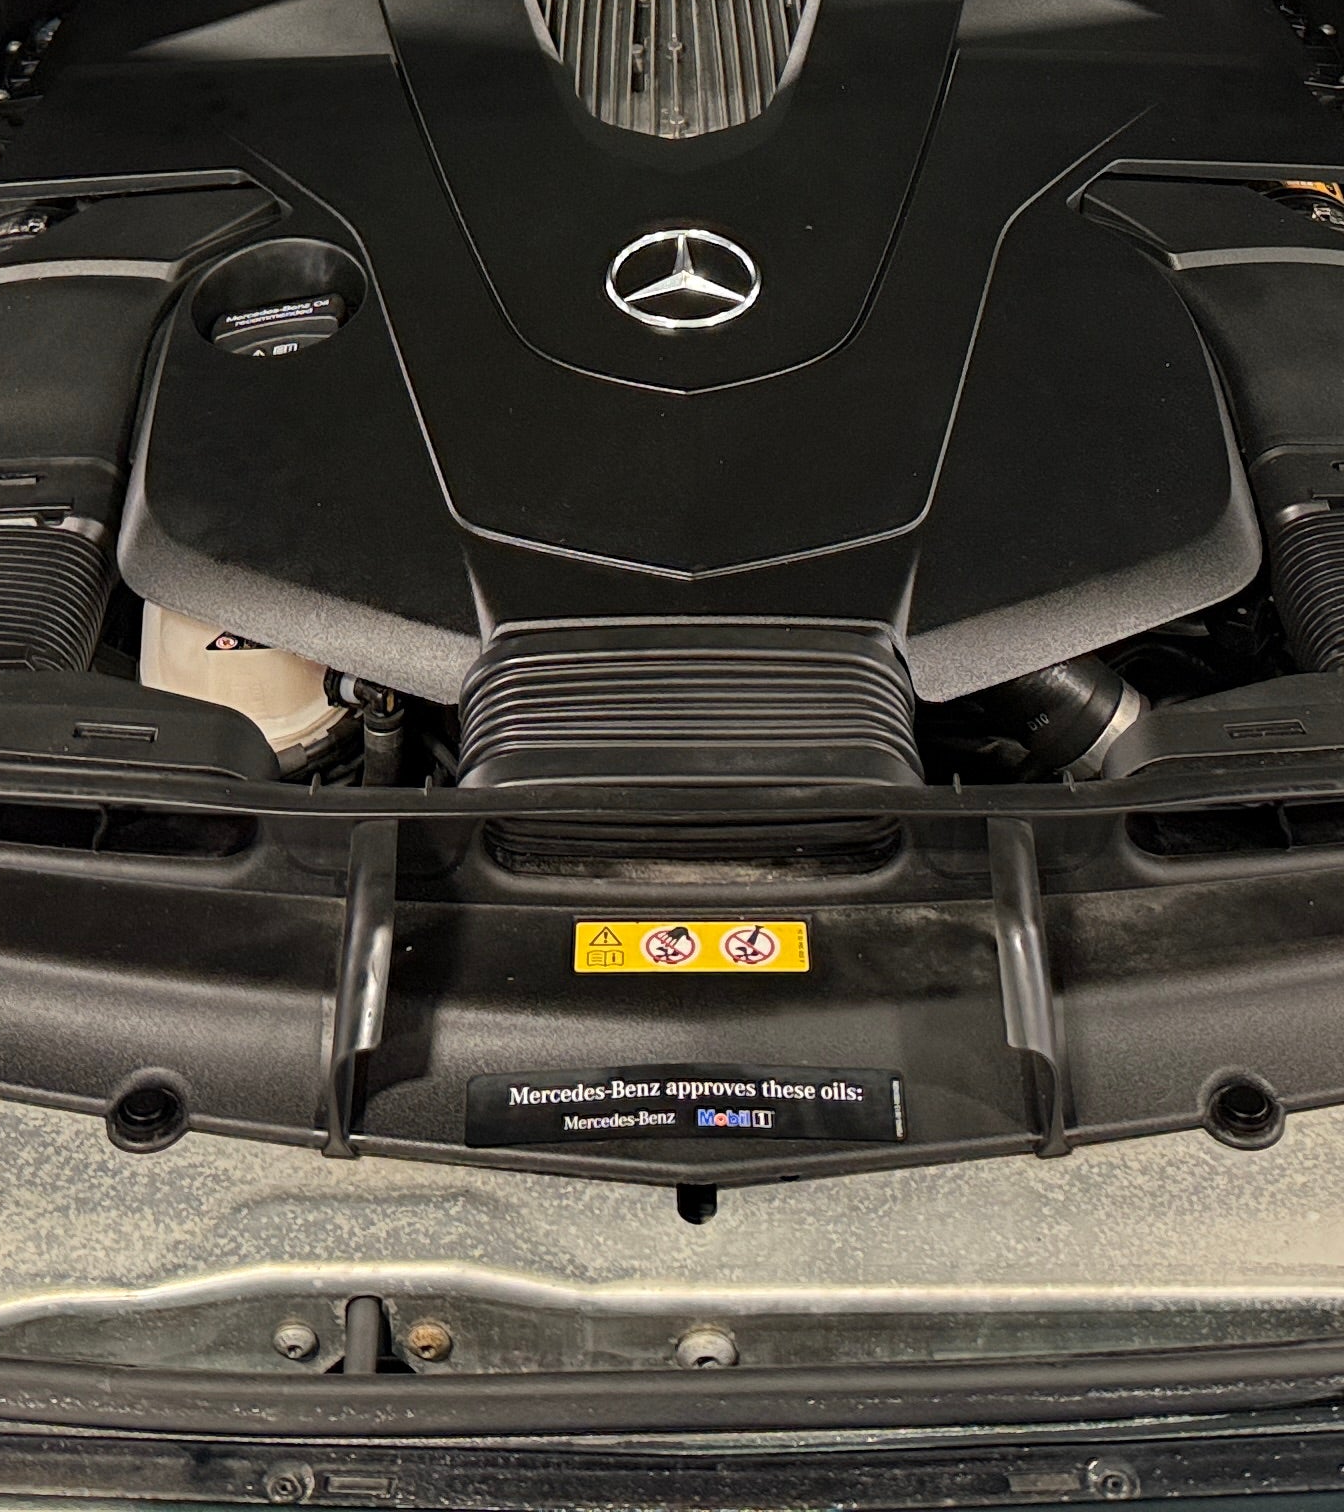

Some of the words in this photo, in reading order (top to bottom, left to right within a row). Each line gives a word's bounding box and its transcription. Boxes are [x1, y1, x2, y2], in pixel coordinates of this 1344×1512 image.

[508, 1080, 661, 1106] Mercedes-Benz
[665, 1080, 756, 1100] approves
[762, 1080, 816, 1099] these
[821, 1082, 864, 1101] oils:
[563, 1110, 676, 1131] Mercedes-Benz
[697, 1108, 752, 1128] Mobil
